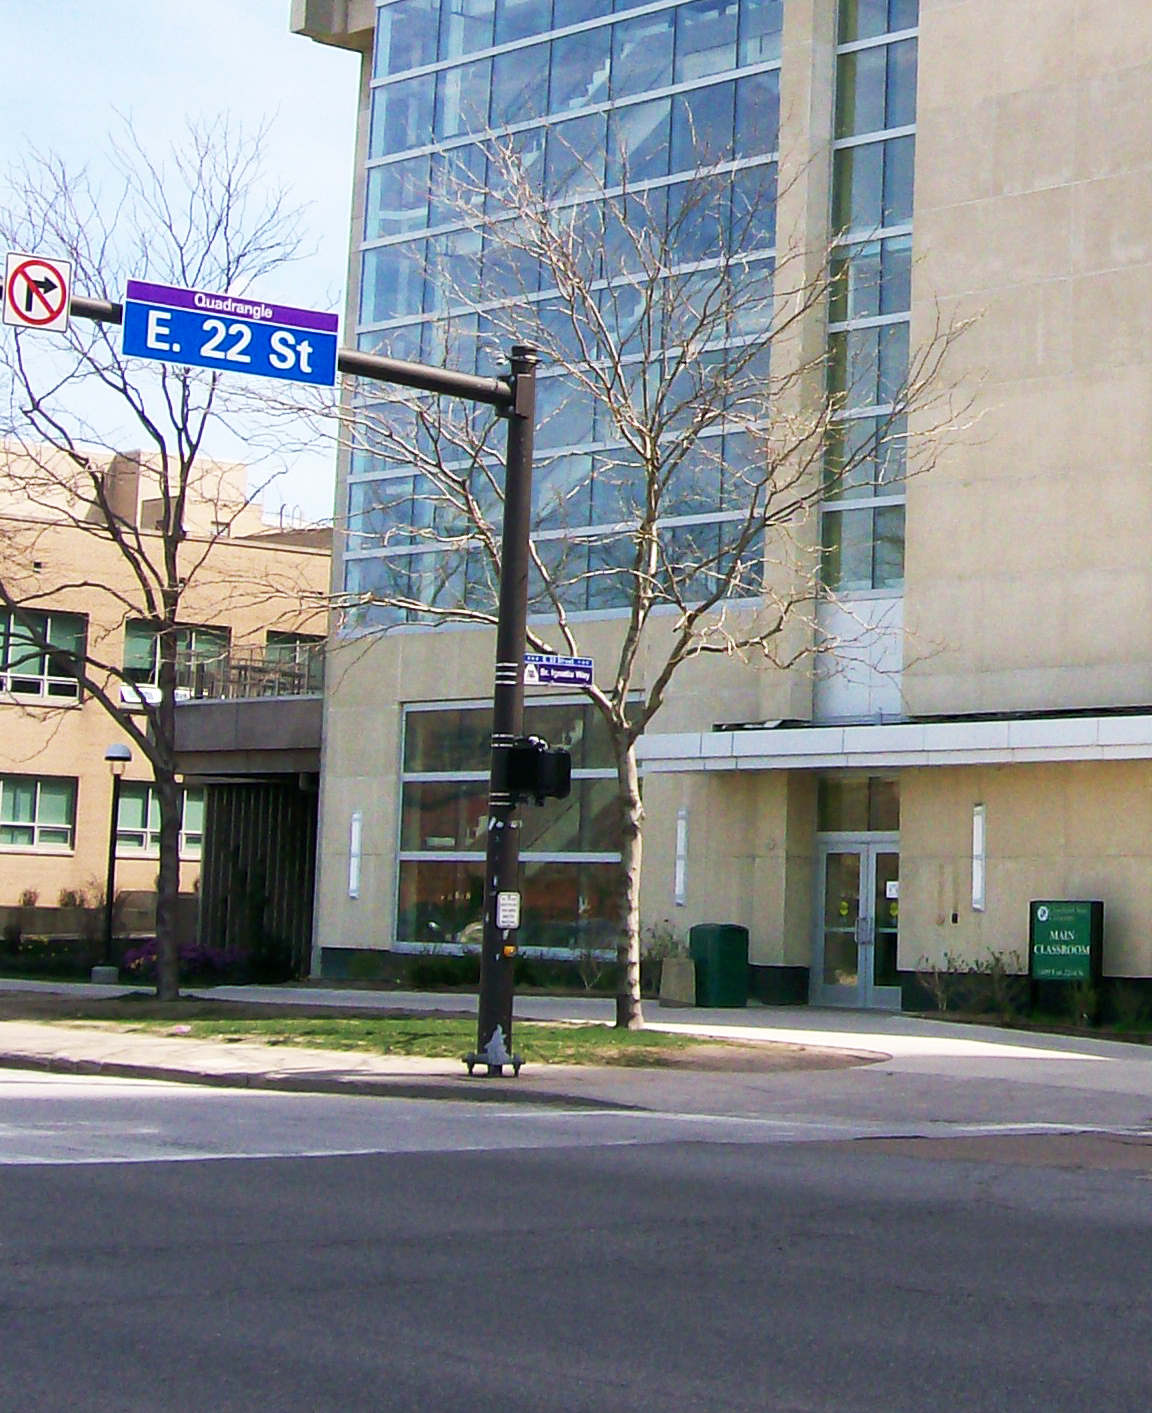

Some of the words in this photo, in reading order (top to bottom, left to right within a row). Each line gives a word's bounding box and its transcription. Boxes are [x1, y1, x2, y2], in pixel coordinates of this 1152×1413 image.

[194, 292, 273, 320] Quadrangle
[146, 309, 181, 353] E.
[200, 319, 251, 363] 22
[268, 330, 313, 374] St
[1049, 930, 1075, 940] MAIN
[1033, 944, 1091, 956] CLASSROOM
